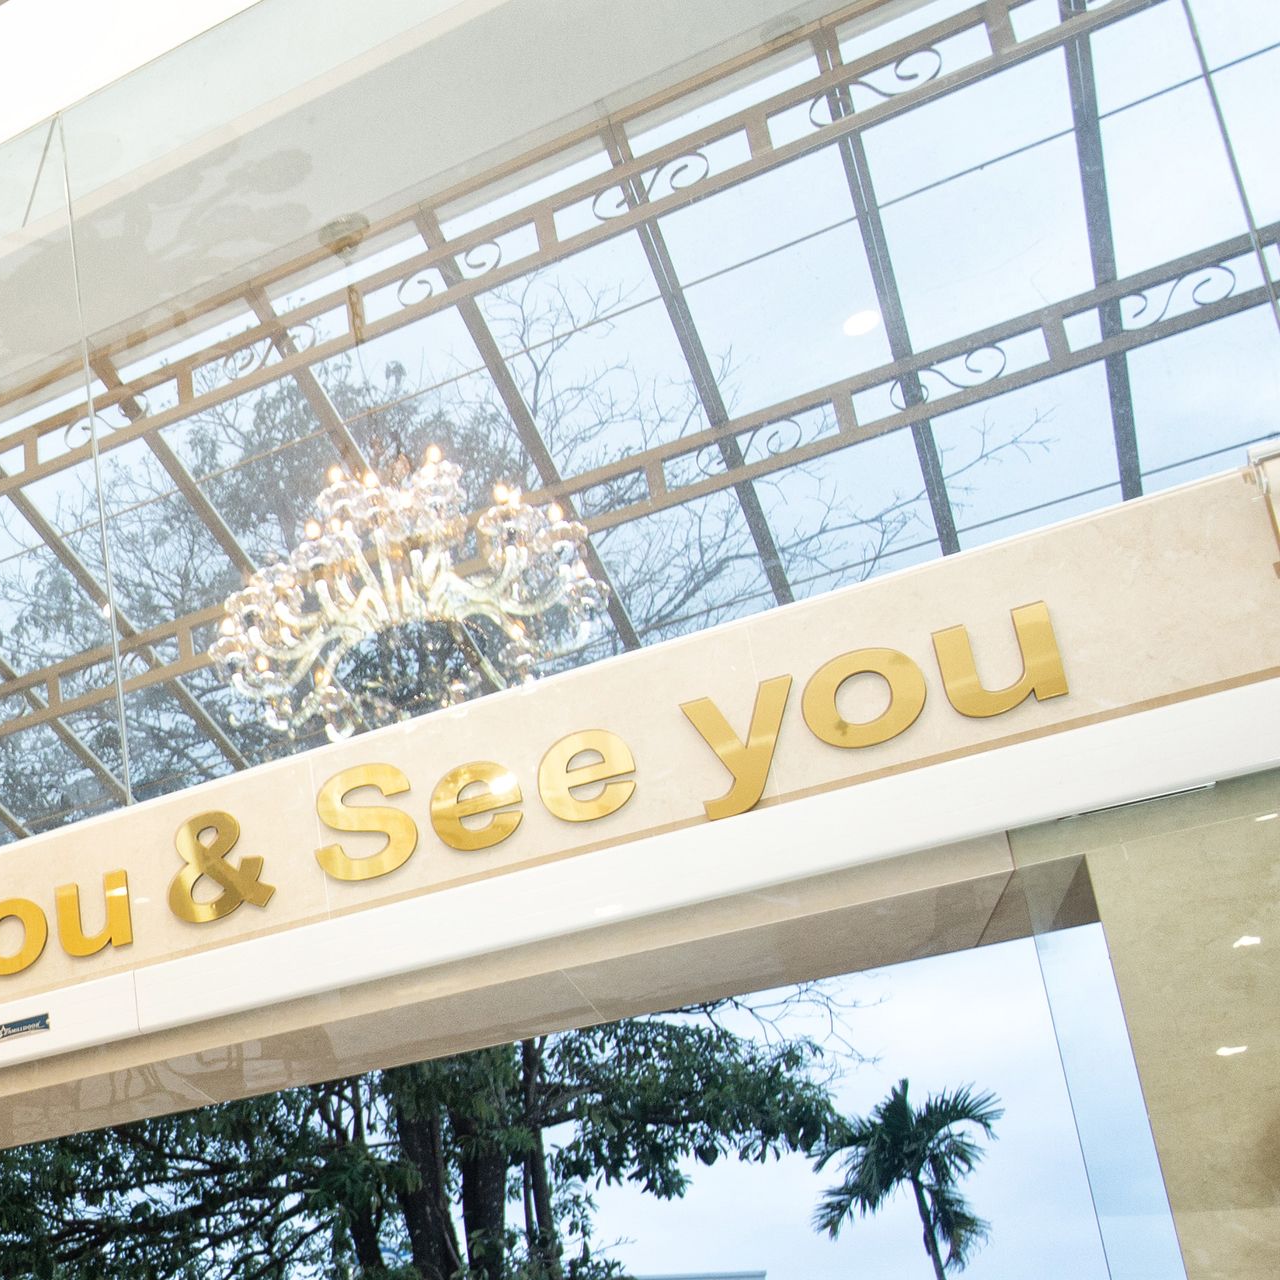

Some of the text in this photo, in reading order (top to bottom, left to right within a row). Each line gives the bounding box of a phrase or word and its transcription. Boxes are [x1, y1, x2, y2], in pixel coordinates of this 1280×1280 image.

[168, 810, 276, 924] &
[315, 729, 636, 881] See
[679, 601, 1071, 821] you
